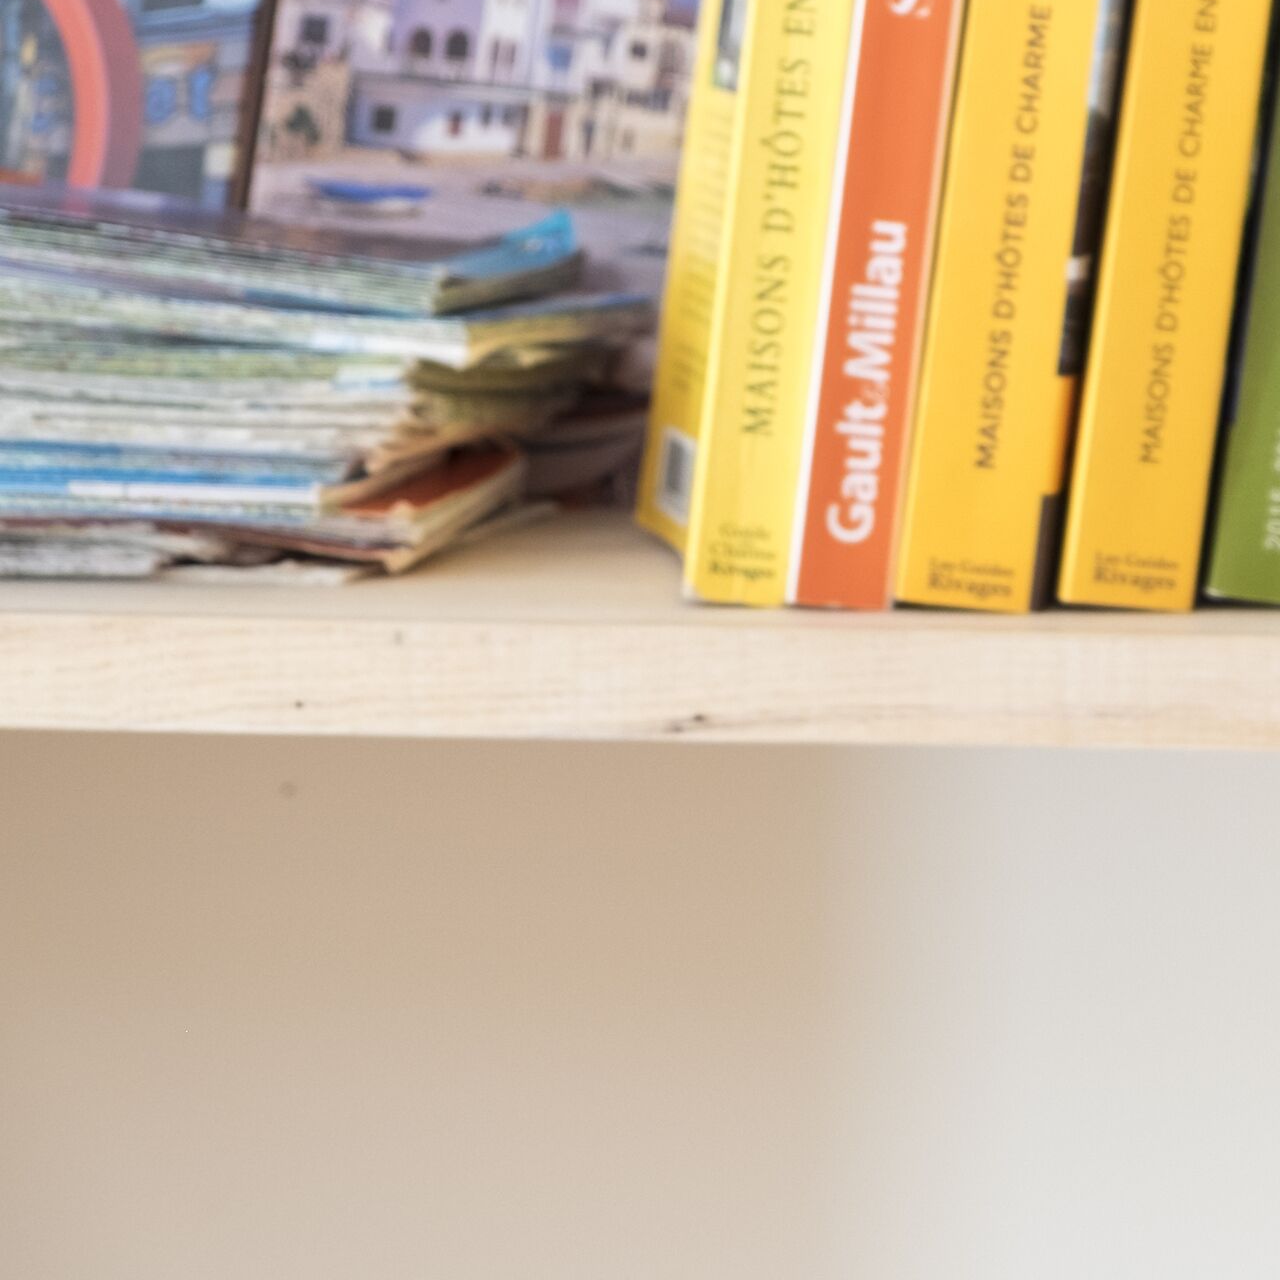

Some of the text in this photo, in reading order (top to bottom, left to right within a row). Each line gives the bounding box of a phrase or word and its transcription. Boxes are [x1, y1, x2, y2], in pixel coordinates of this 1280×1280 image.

[1016, 4, 1052, 135] CHARME
[1178, 44, 1213, 158] CHARME
[761, 56, 811, 234] D'HÔTES
[1009, 143, 1035, 184] DE
[1173, 168, 1197, 205] DE
[993, 192, 1028, 320] D'HÔTES
[1156, 216, 1190, 333] D'HÔTES
[740, 253, 790, 439] MAISONS
[975, 330, 1013, 469] MAISONS
[1140, 342, 1175, 465] MAISONS
[928, 571, 1012, 597] Rivages
[1093, 566, 1177, 592] Rivages
